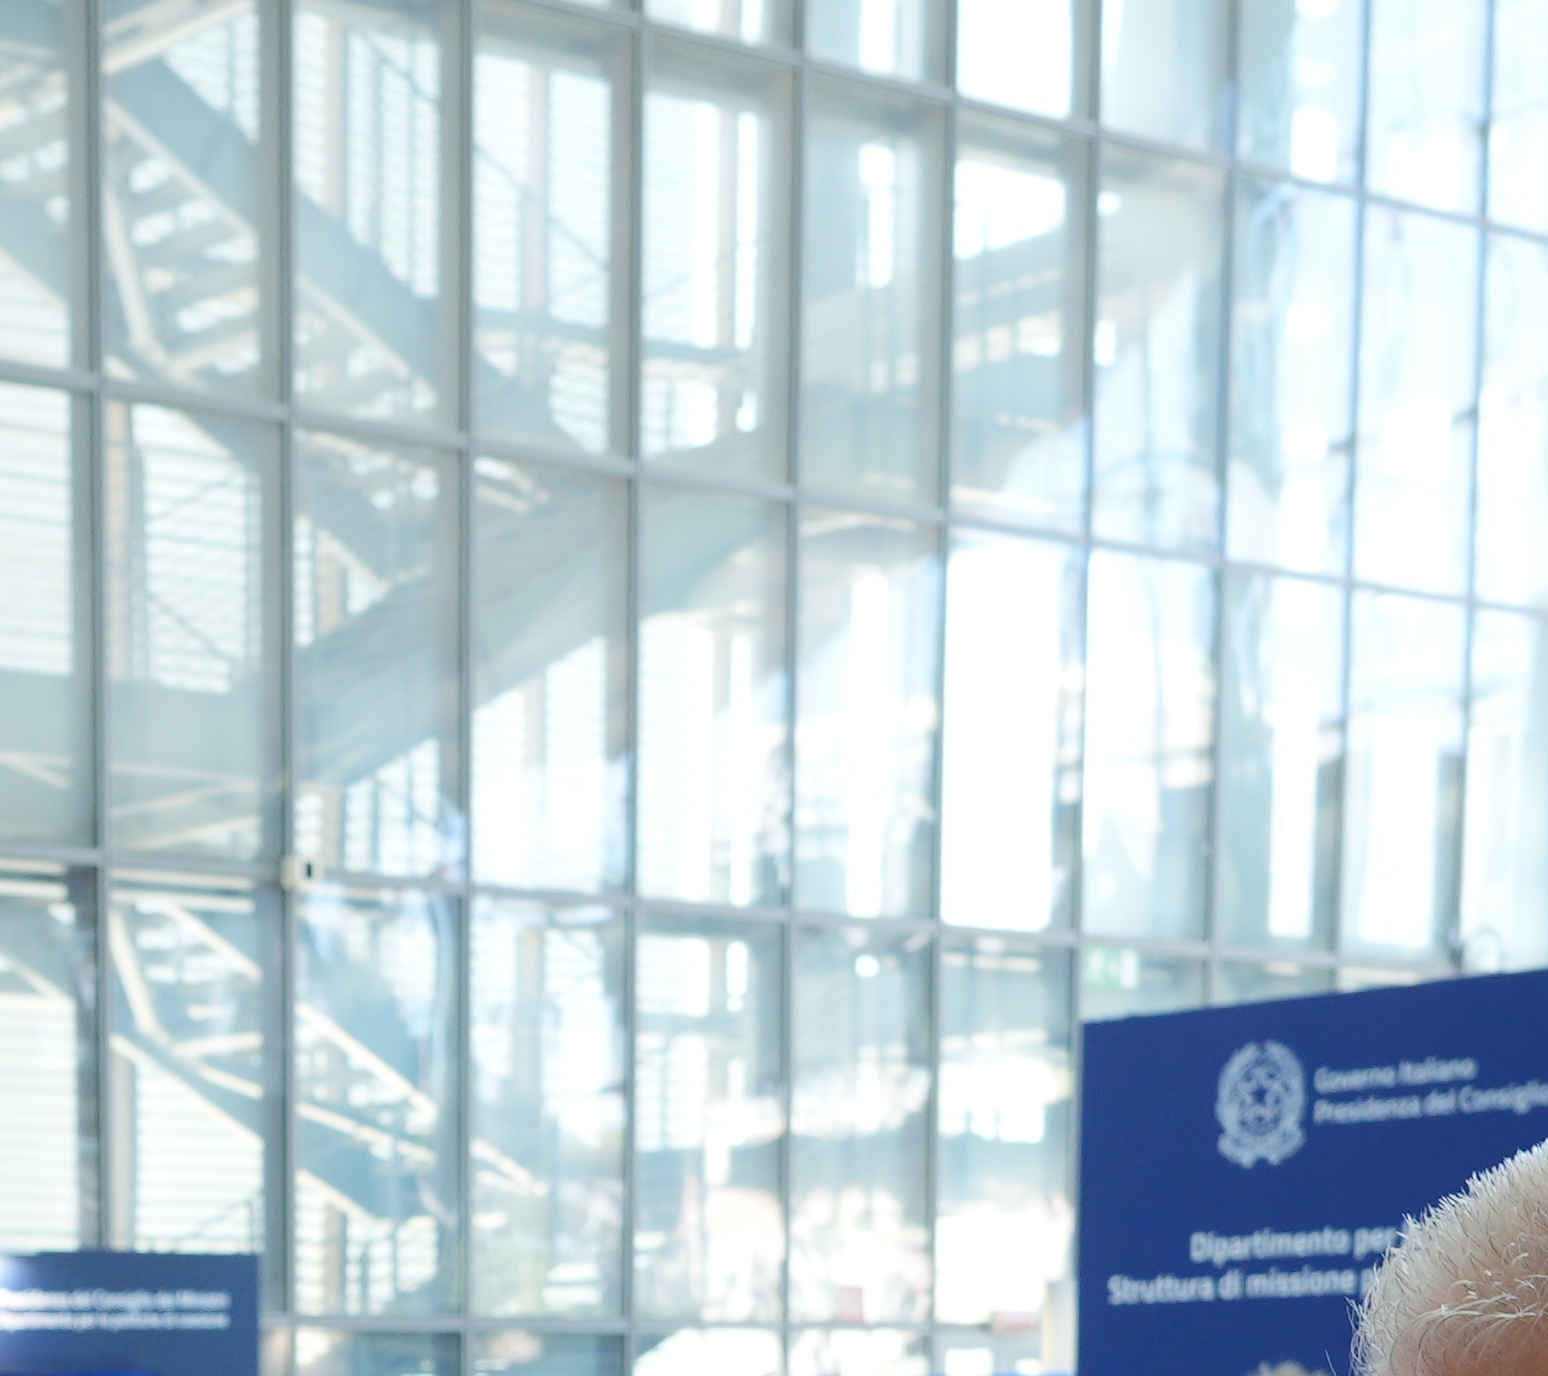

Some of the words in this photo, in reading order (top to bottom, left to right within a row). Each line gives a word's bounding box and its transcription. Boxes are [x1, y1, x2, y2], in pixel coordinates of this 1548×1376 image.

[1190, 1225, 1351, 1268] Dipartimento
[1107, 1273, 1215, 1306] Struttura
[1217, 1268, 1245, 1300] di
[1245, 1264, 1356, 1299] missione
